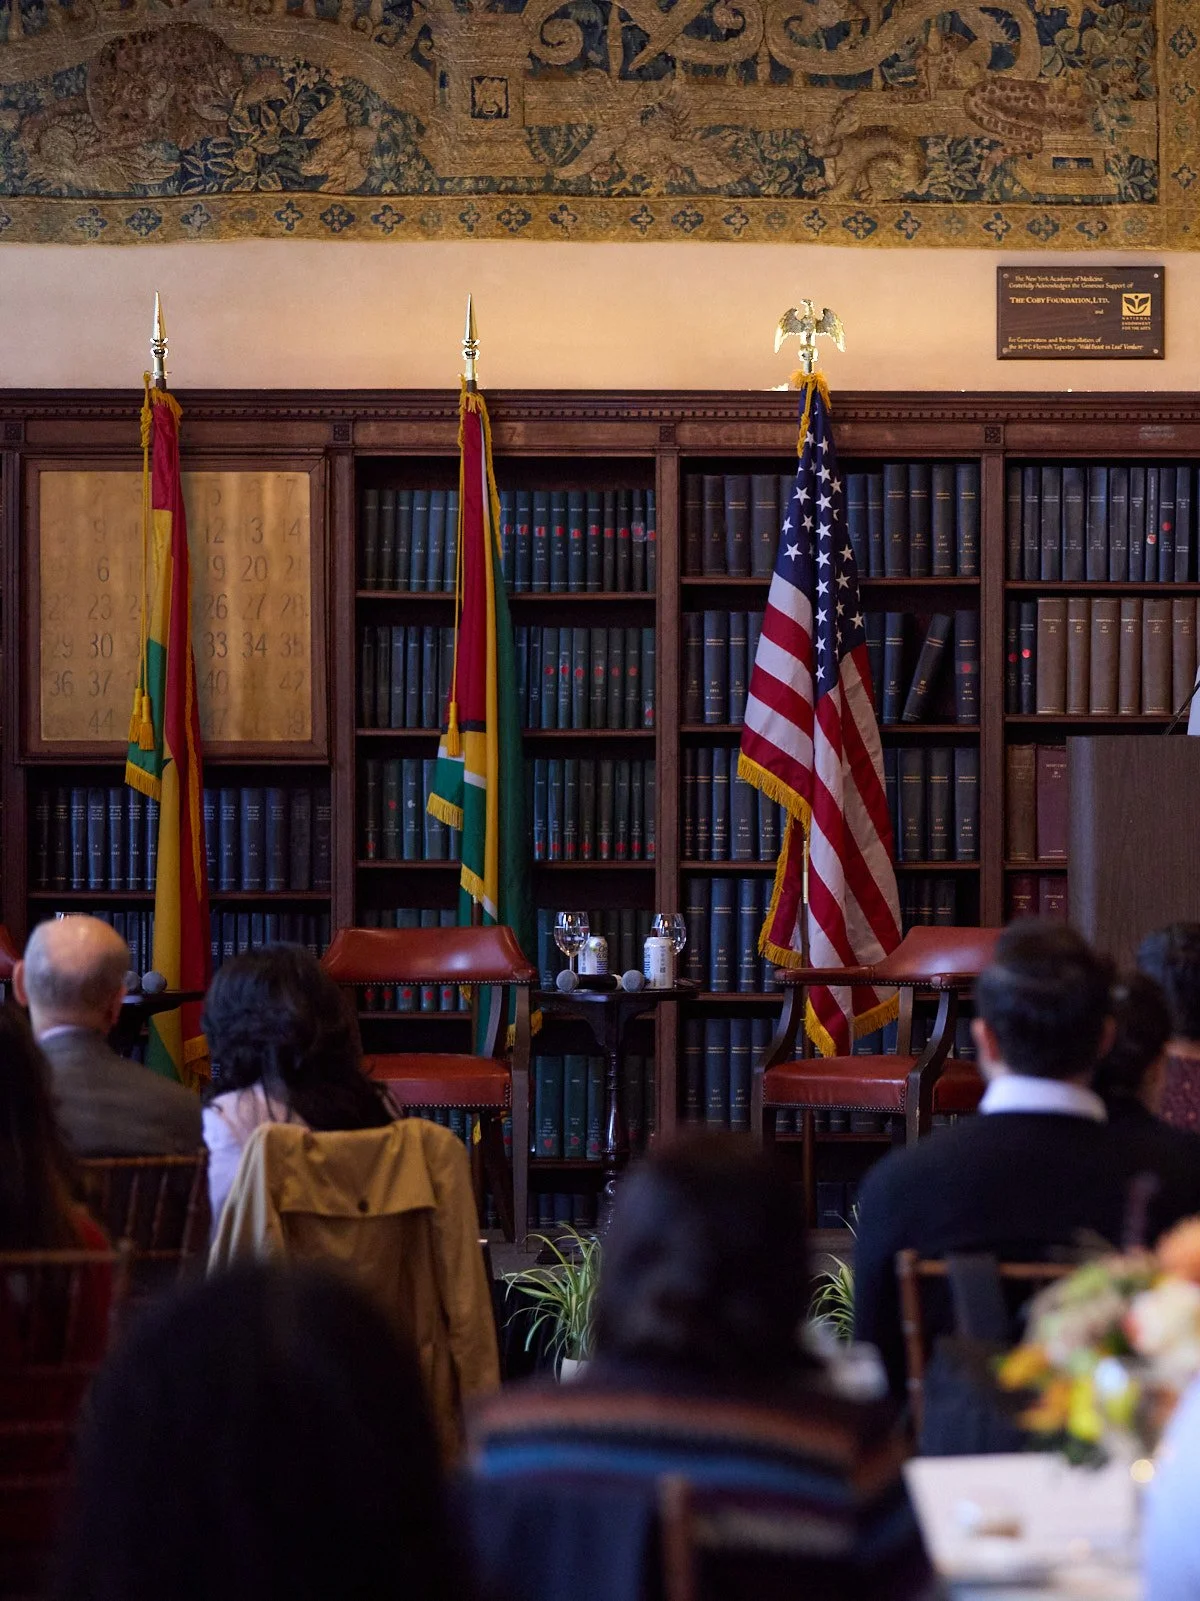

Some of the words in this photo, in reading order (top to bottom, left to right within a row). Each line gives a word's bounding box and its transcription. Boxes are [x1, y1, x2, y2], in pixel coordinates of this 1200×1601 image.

[204, 516, 226, 545] 12
[241, 554, 268, 583] 20
[86, 594, 112, 621] 23
[203, 593, 229, 620] 26
[88, 631, 114, 660] 30
[203, 631, 228, 659] 33
[242, 631, 269, 658] 34
[48, 670, 74, 698] 36
[88, 670, 114, 698] 37
